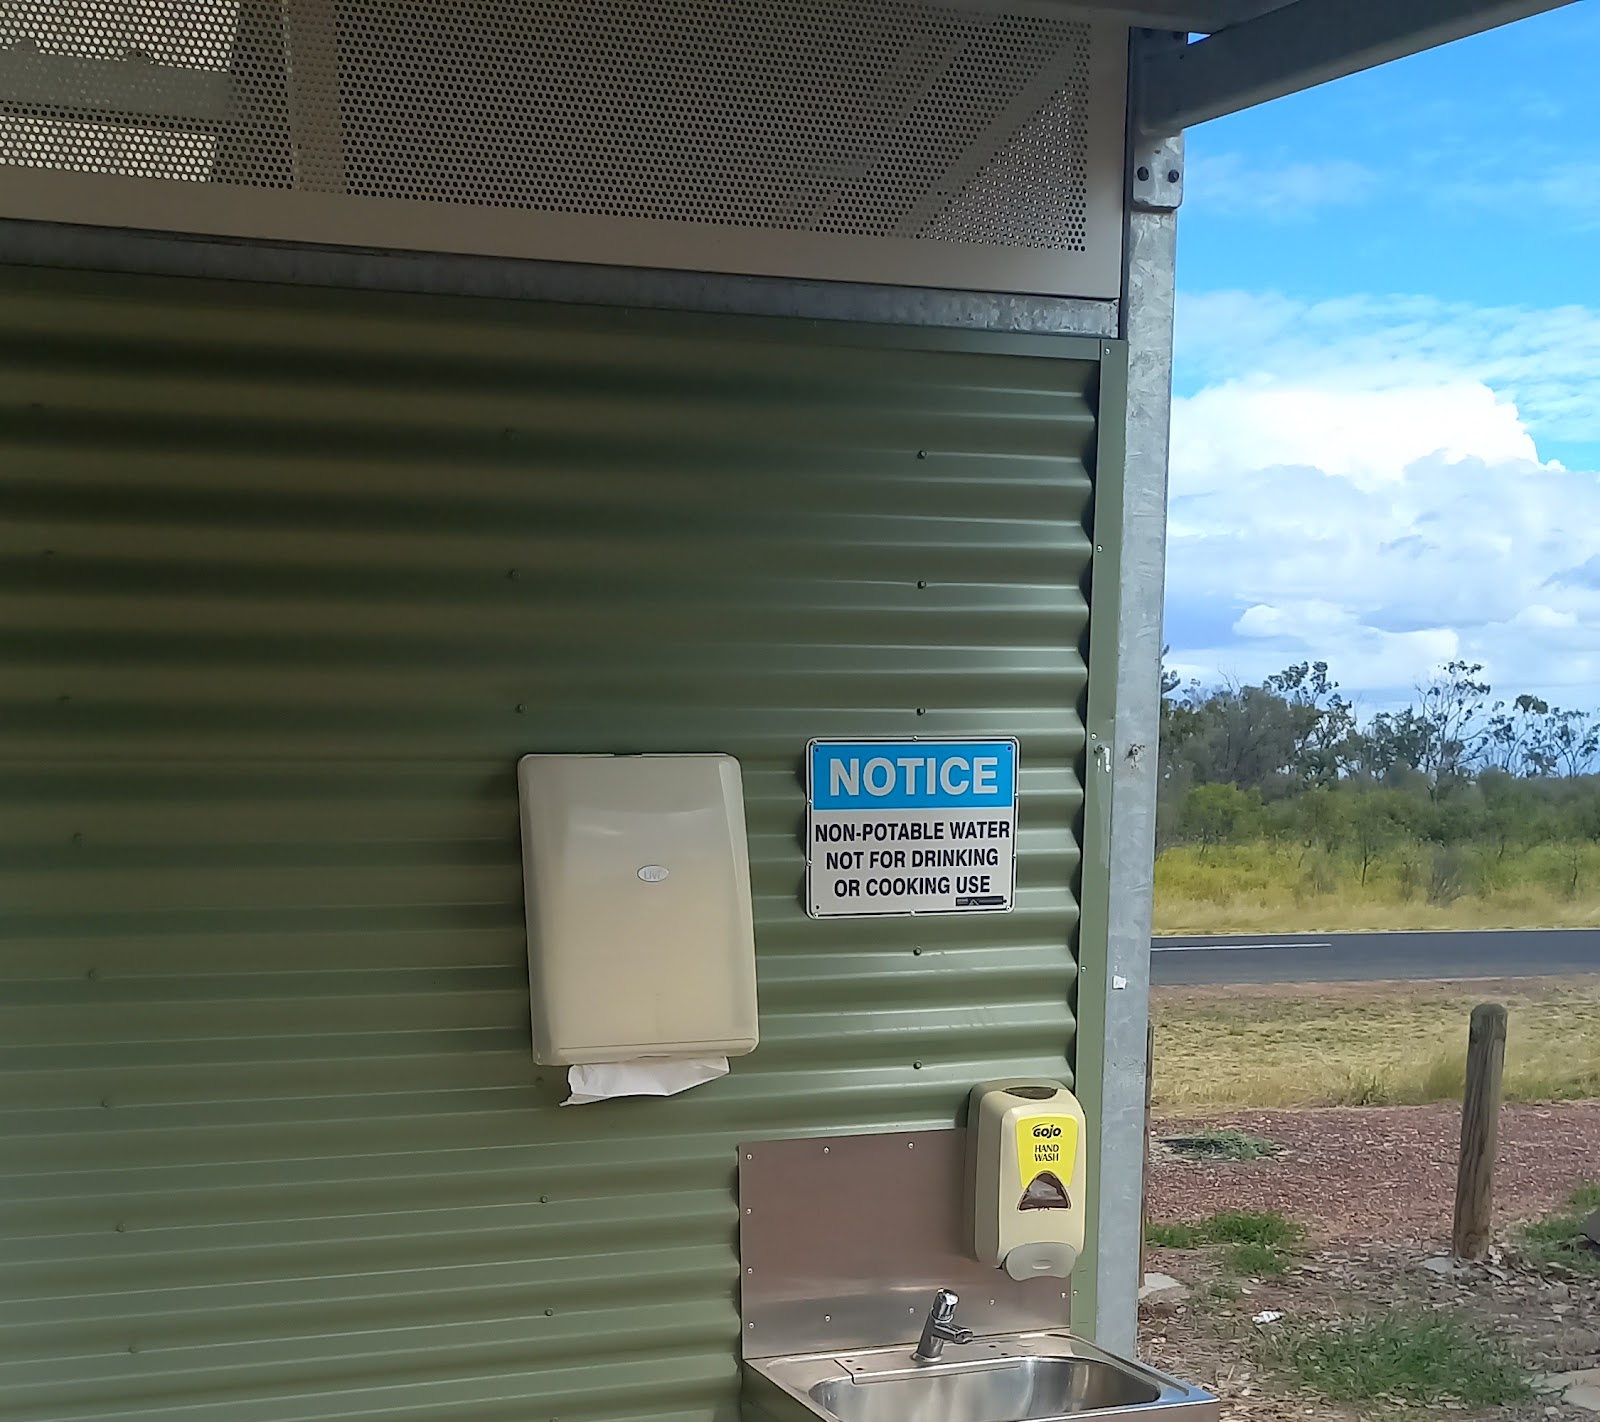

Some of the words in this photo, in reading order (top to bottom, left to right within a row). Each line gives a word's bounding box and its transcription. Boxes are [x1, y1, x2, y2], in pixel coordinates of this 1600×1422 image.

[829, 756, 998, 797] NOTICE
[815, 822, 944, 842] NON-POTABLE
[950, 821, 1010, 839] WATER
[826, 851, 864, 870] NOT
[869, 850, 906, 869] FOR
[912, 848, 998, 868] DRINKING
[834, 879, 860, 897] OR
[866, 876, 950, 896] COOKING
[956, 875, 991, 894] USE
[1034, 1144, 1060, 1153] HAND
[1034, 1153, 1059, 1162] WASH
